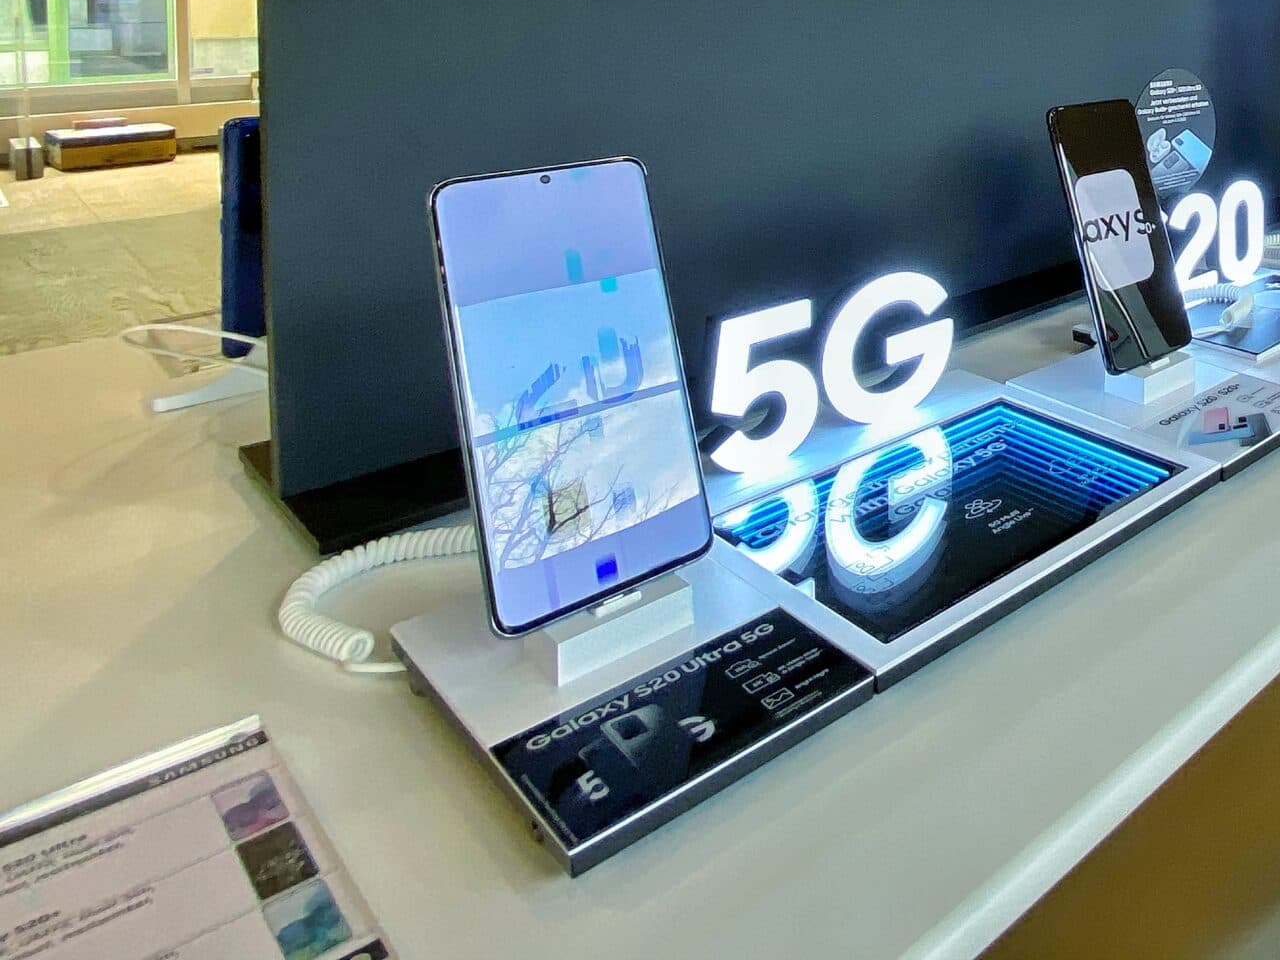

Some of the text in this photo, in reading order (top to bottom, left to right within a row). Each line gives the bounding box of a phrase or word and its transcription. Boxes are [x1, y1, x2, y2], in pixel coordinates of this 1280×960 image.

[1160, 180, 1264, 292] 20
[710, 271, 954, 474] 5G
[1159, 404, 1201, 426] Galaxy
[1198, 394, 1218, 408] S20
[526, 694, 630, 750] Galaxy
[634, 670, 681, 698] S20
[680, 642, 742, 673] Ultra
[741, 623, 774, 644] 5G
